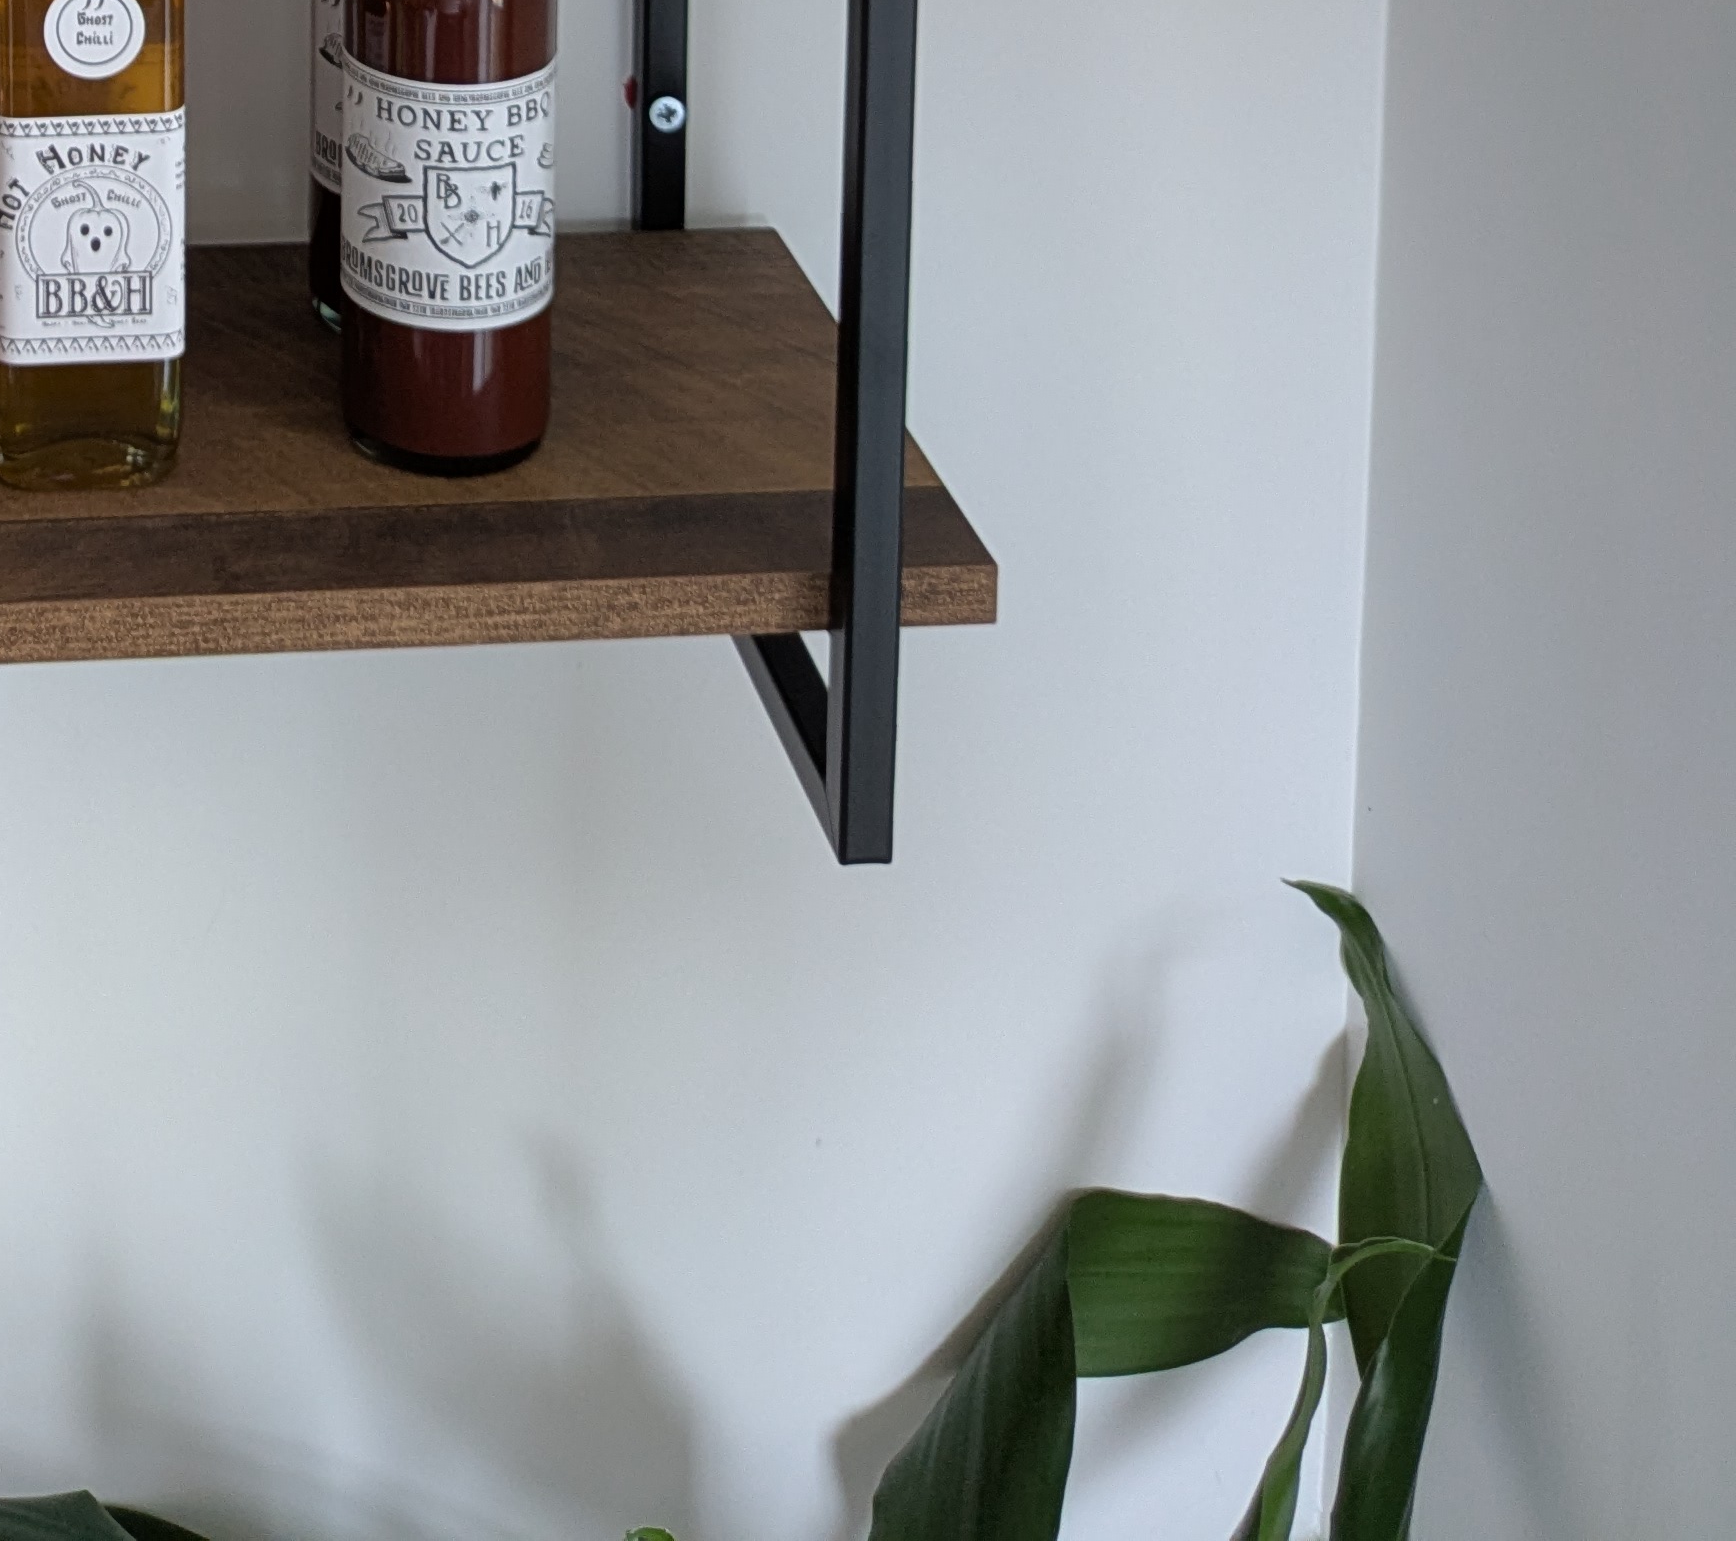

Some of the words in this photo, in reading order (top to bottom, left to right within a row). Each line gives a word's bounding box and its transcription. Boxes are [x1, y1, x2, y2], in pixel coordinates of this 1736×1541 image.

[77, 10, 114, 26] GHOST
[375, 96, 494, 132] HONEY
[35, 143, 151, 175] HONEY
[414, 133, 525, 164] SAUCE
[51, 191, 87, 209] GHOST
[106, 188, 142, 209] CHILLI
[396, 203, 419, 224] 20
[519, 198, 533, 220] 16
[341, 236, 450, 301] BROMSGROVE
[459, 269, 508, 302] BEES
[514, 256, 544, 294] AND
[41, 275, 148, 316] BB&H
